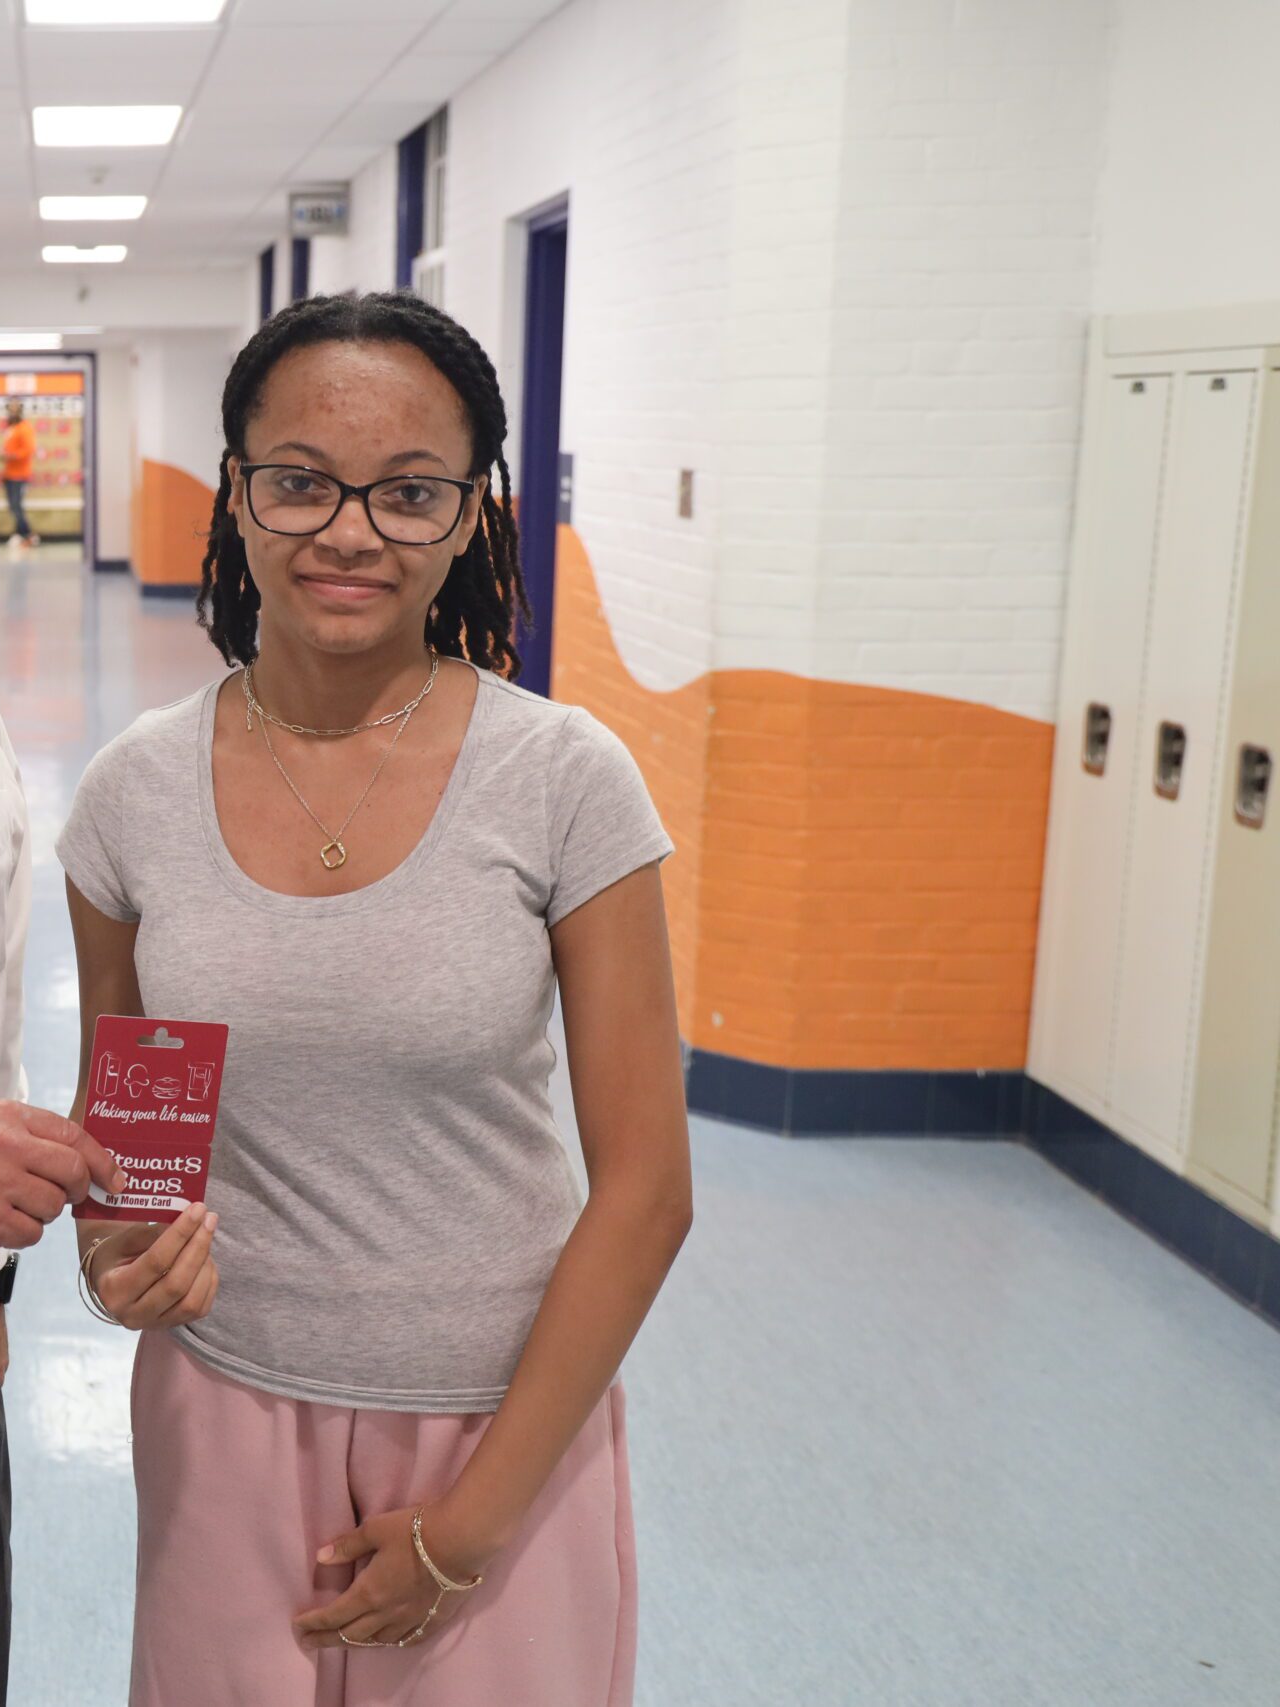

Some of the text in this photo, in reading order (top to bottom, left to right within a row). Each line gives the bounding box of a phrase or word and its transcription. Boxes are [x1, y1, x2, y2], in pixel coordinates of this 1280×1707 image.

[89, 1100, 211, 1124] Making your life easier
[106, 1195, 172, 1207] My Money Card
